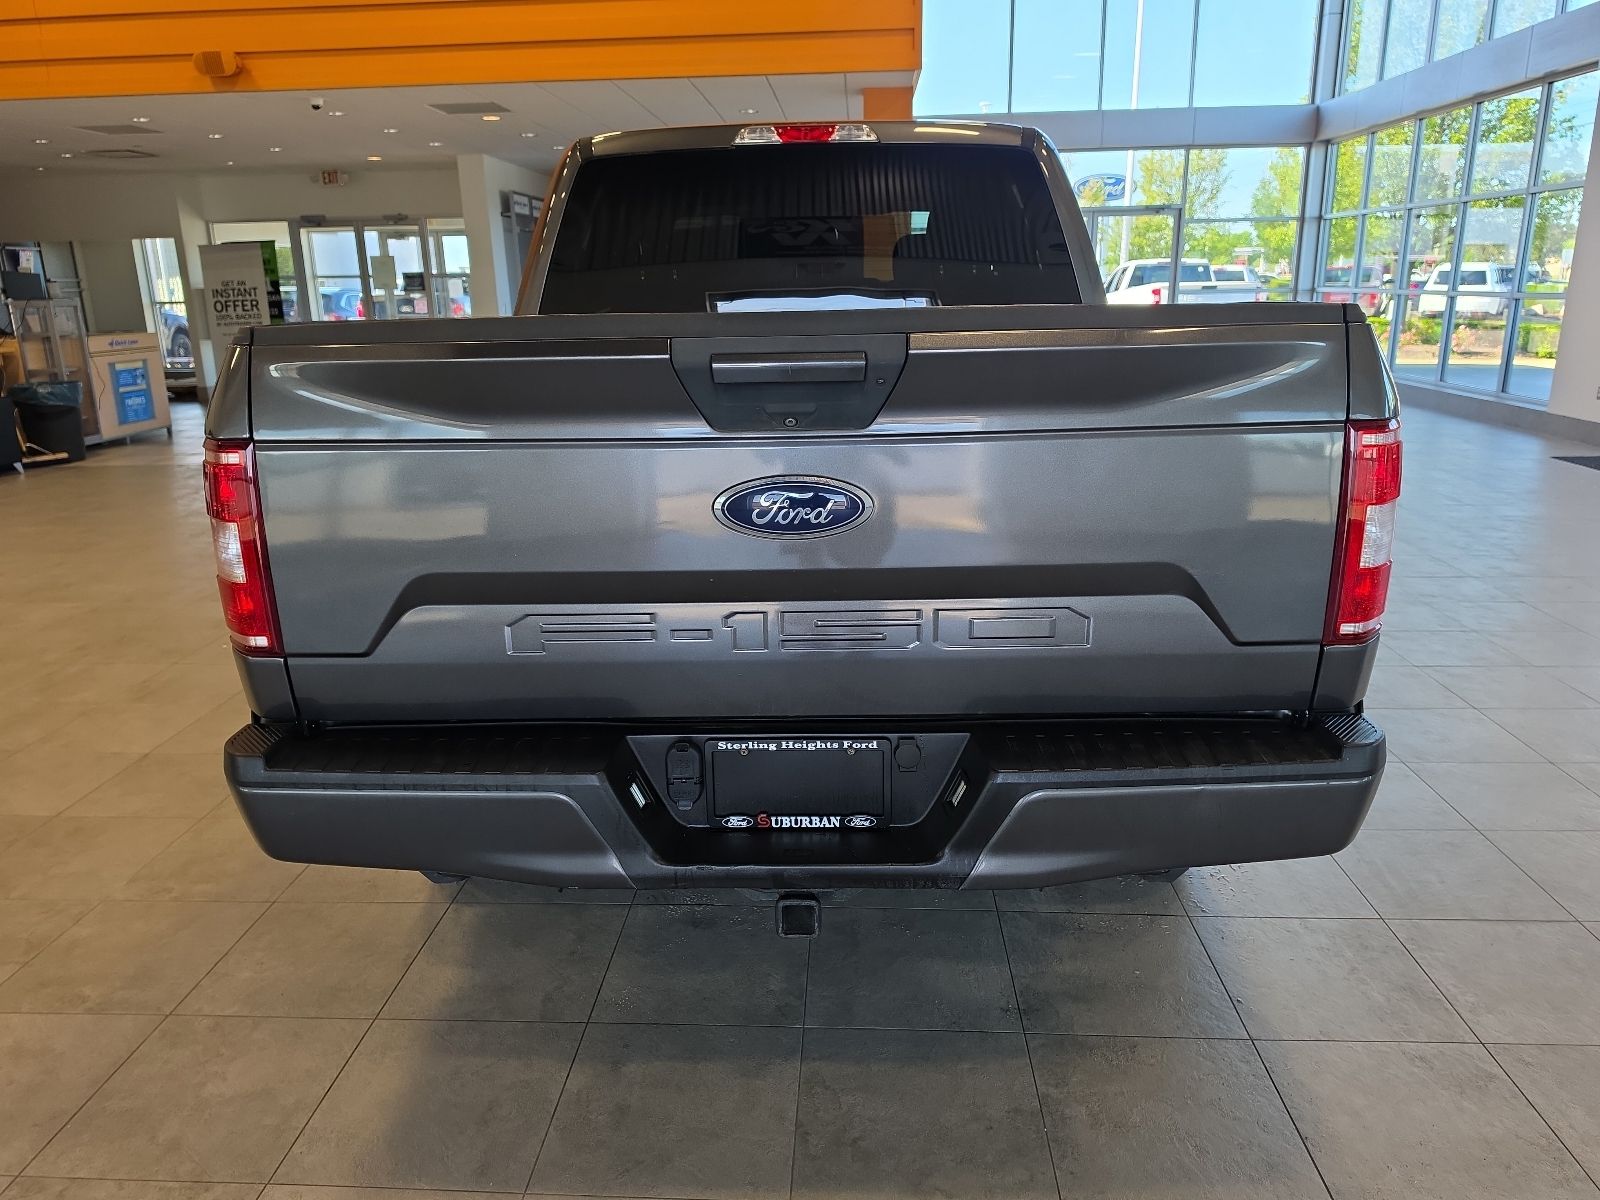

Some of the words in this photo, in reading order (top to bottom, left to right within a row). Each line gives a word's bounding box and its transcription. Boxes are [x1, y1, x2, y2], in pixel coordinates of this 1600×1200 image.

[322, 170, 338, 185] EXIT
[212, 287, 258, 299] INSTANT
[213, 300, 260, 313] OFFER
[752, 490, 834, 525] Ford
[505, 607, 1091, 655] F-150
[717, 741, 778, 751] Sterling
[780, 741, 839, 750] Heights
[842, 741, 878, 749] Ford
[727, 816, 748, 826] Ford
[757, 813, 840, 828] SUBURBAN
[850, 816, 871, 826] Ford
